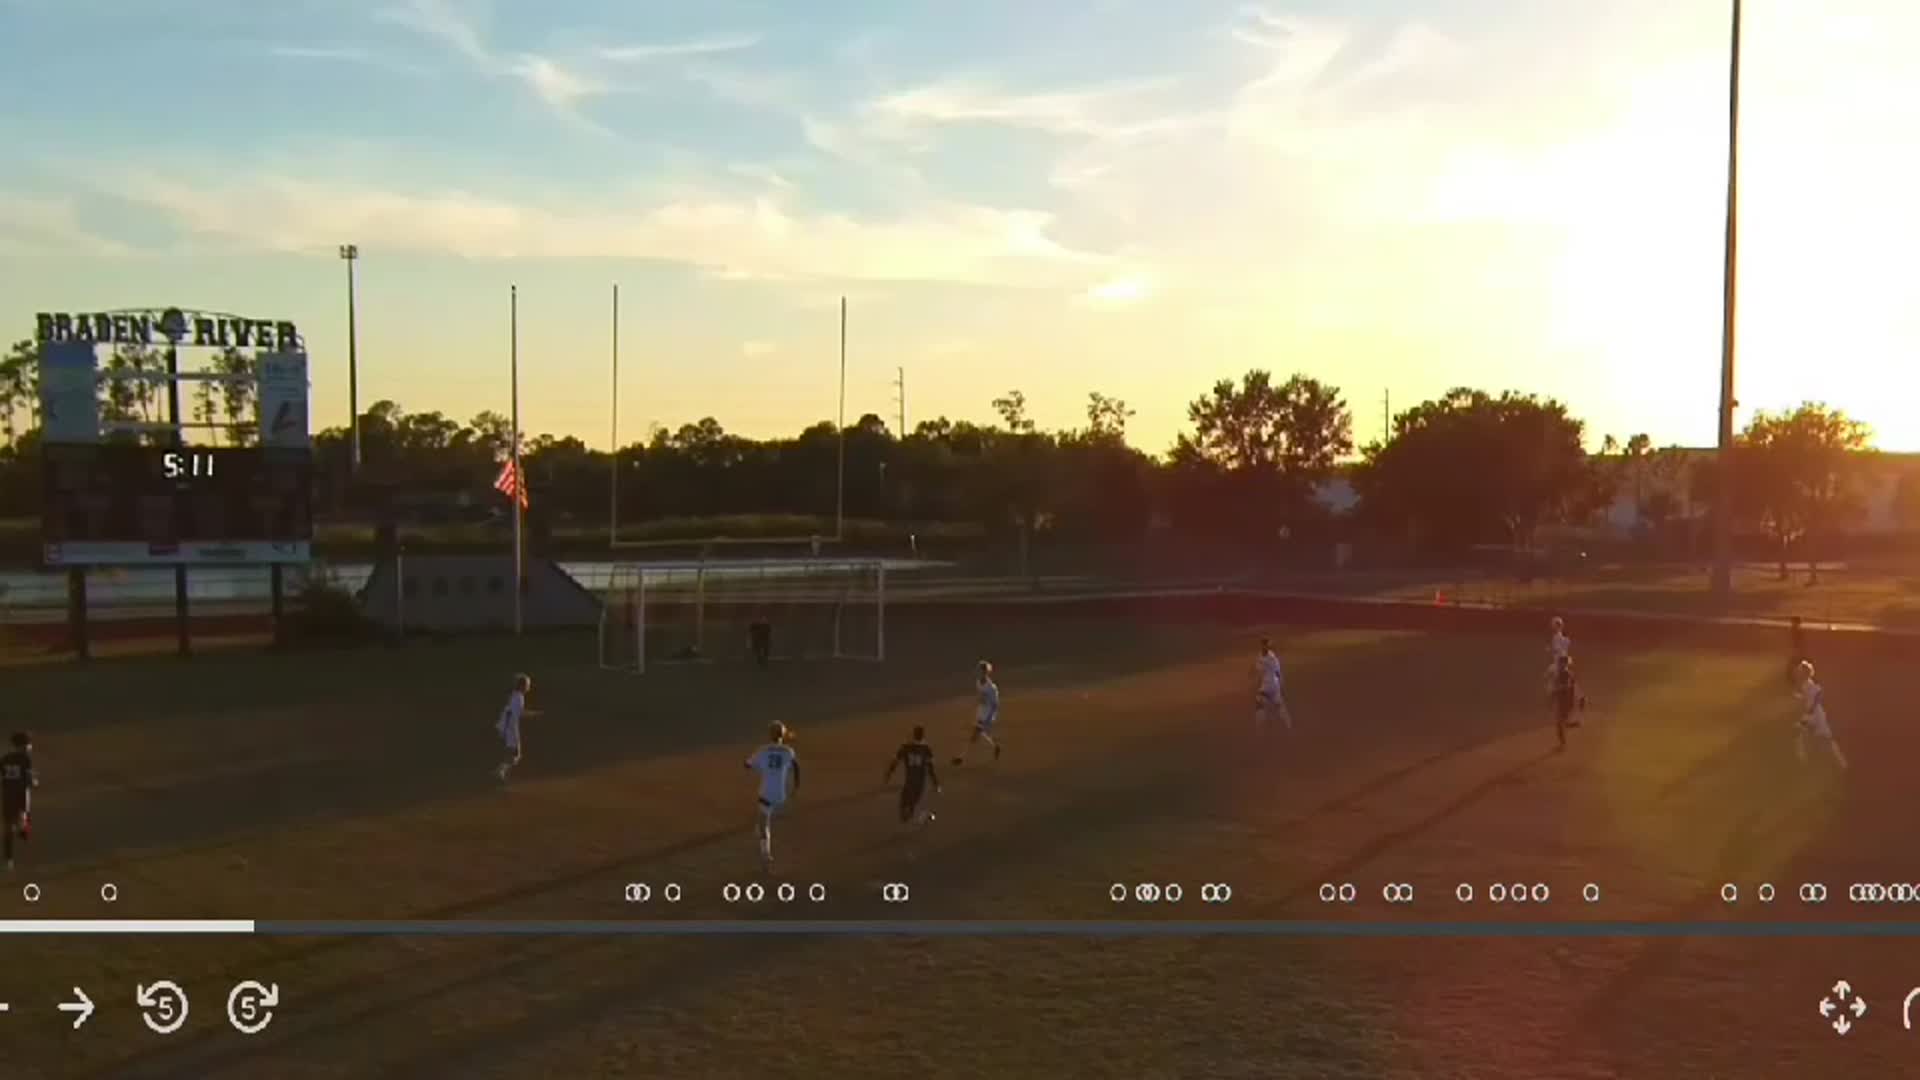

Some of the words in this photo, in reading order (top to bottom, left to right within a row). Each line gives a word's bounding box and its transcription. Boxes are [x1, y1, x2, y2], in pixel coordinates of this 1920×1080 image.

[36, 312, 152, 343] BRADEN
[194, 317, 301, 350] RIVER
[163, 453, 214, 478] 5:11
